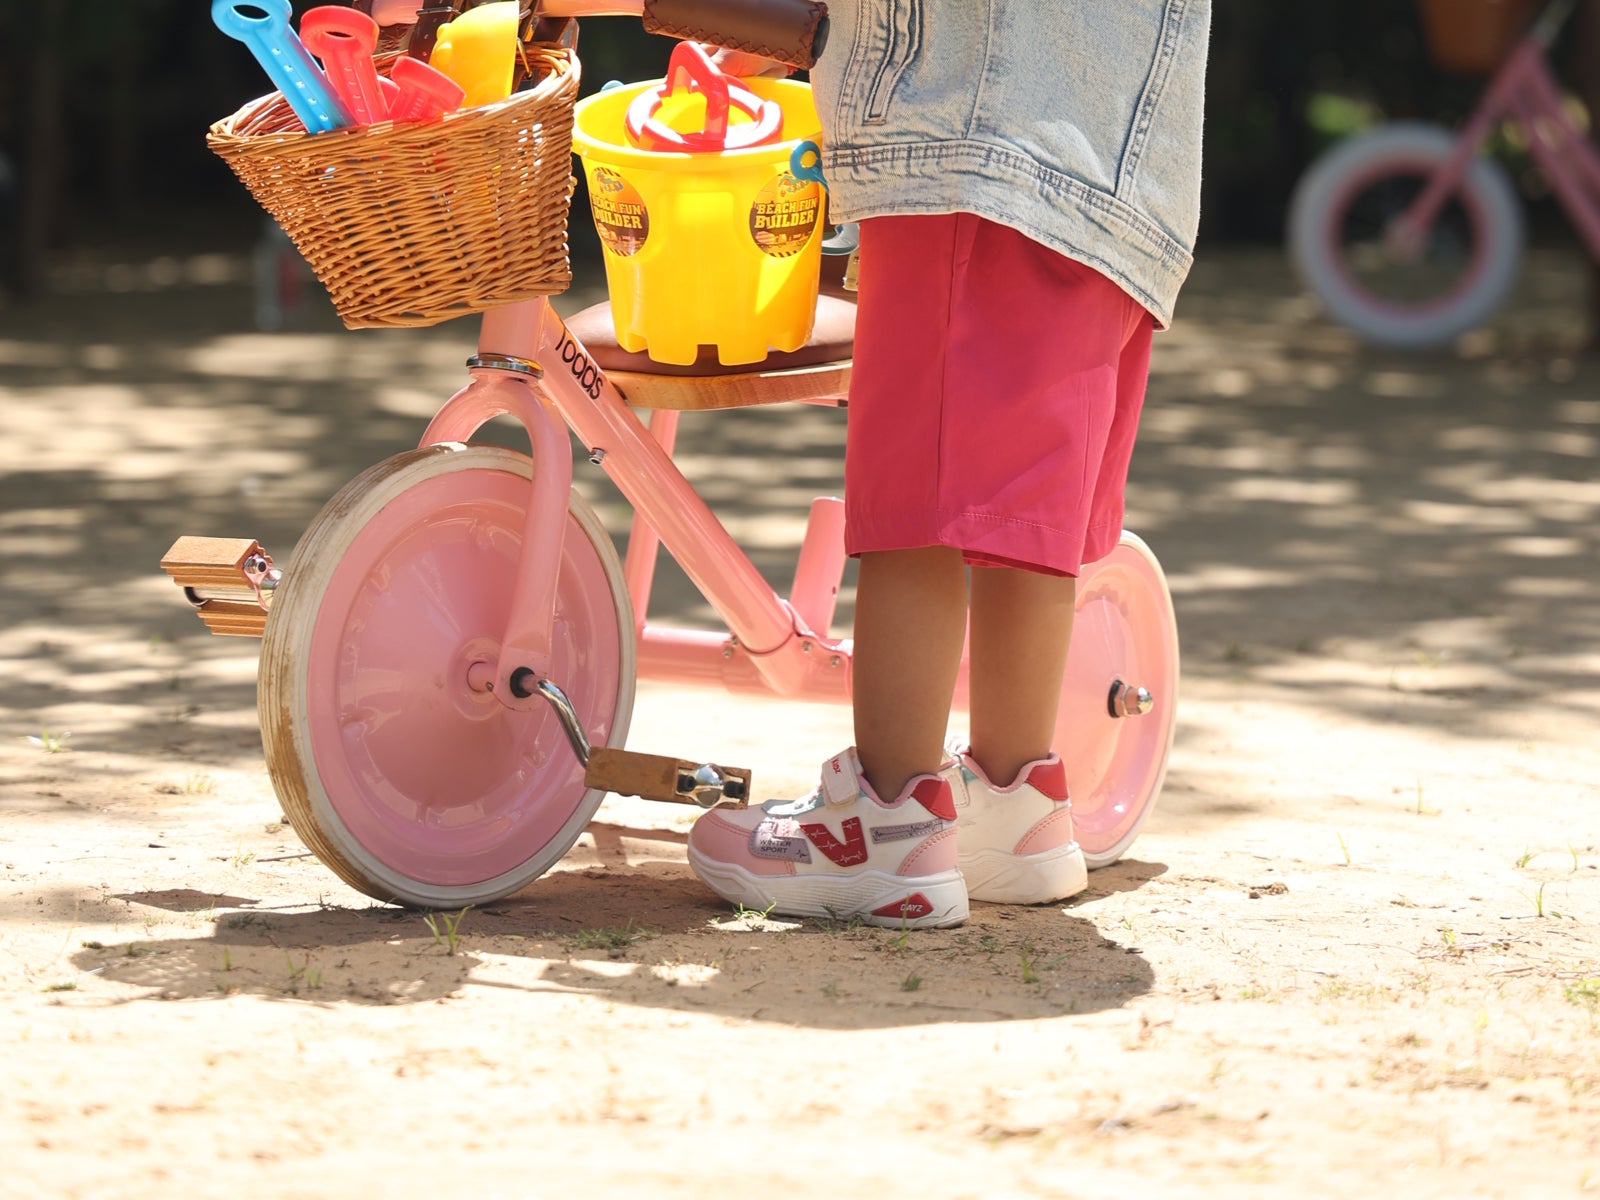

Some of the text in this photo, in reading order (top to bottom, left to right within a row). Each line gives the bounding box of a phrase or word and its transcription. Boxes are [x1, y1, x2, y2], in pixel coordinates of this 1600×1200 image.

[618, 203, 641, 215] FUN
[756, 198, 817, 215] BEACH FUN
[754, 210, 814, 229] BUILDER
[760, 839, 791, 847] WINTER
